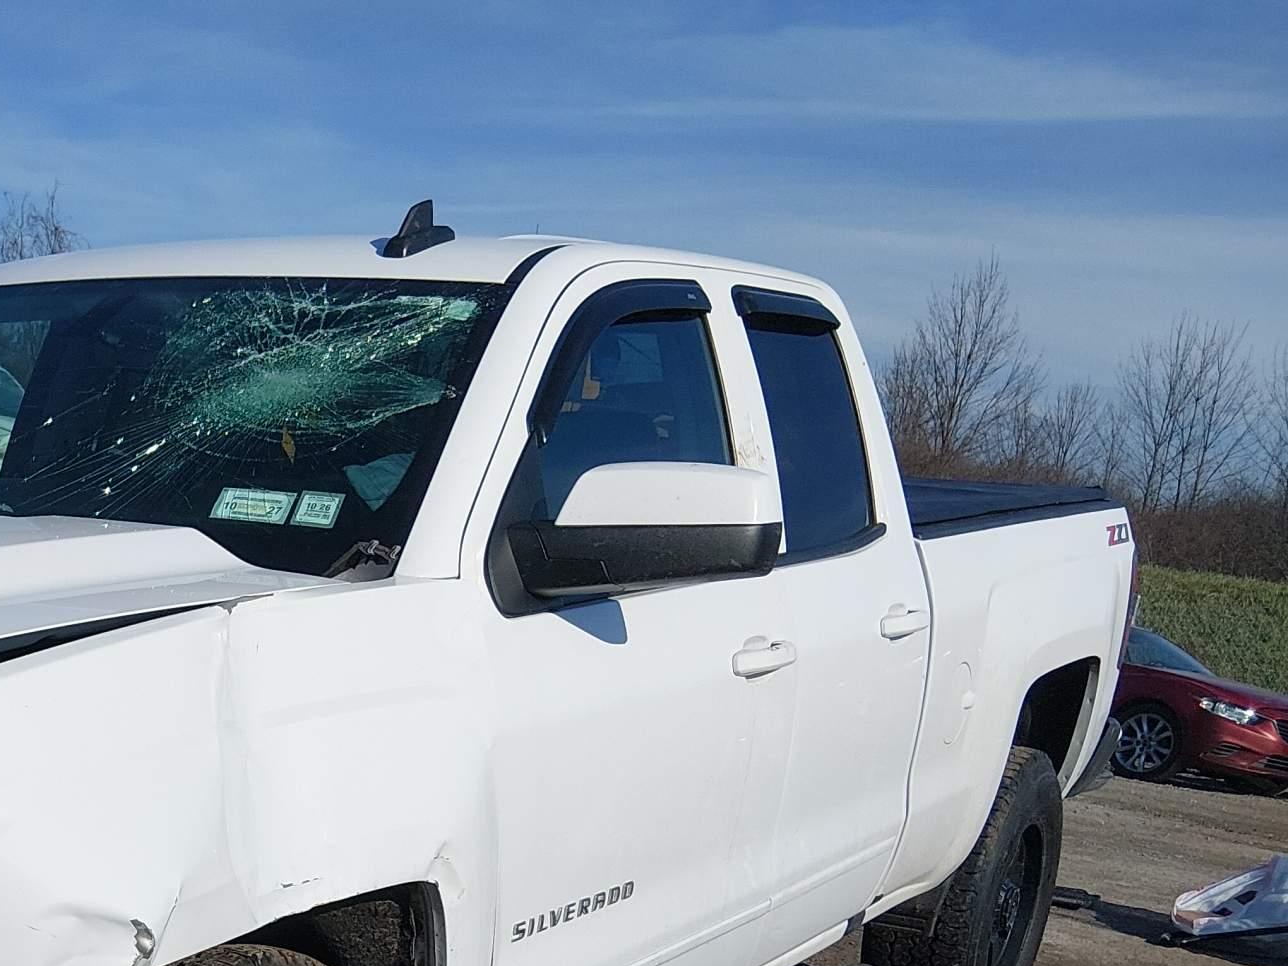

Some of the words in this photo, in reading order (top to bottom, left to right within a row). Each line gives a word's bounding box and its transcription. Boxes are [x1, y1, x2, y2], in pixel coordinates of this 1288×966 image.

[224, 501, 237, 510] 10
[266, 506, 283, 515] 27
[510, 880, 635, 943] SILVERADO
